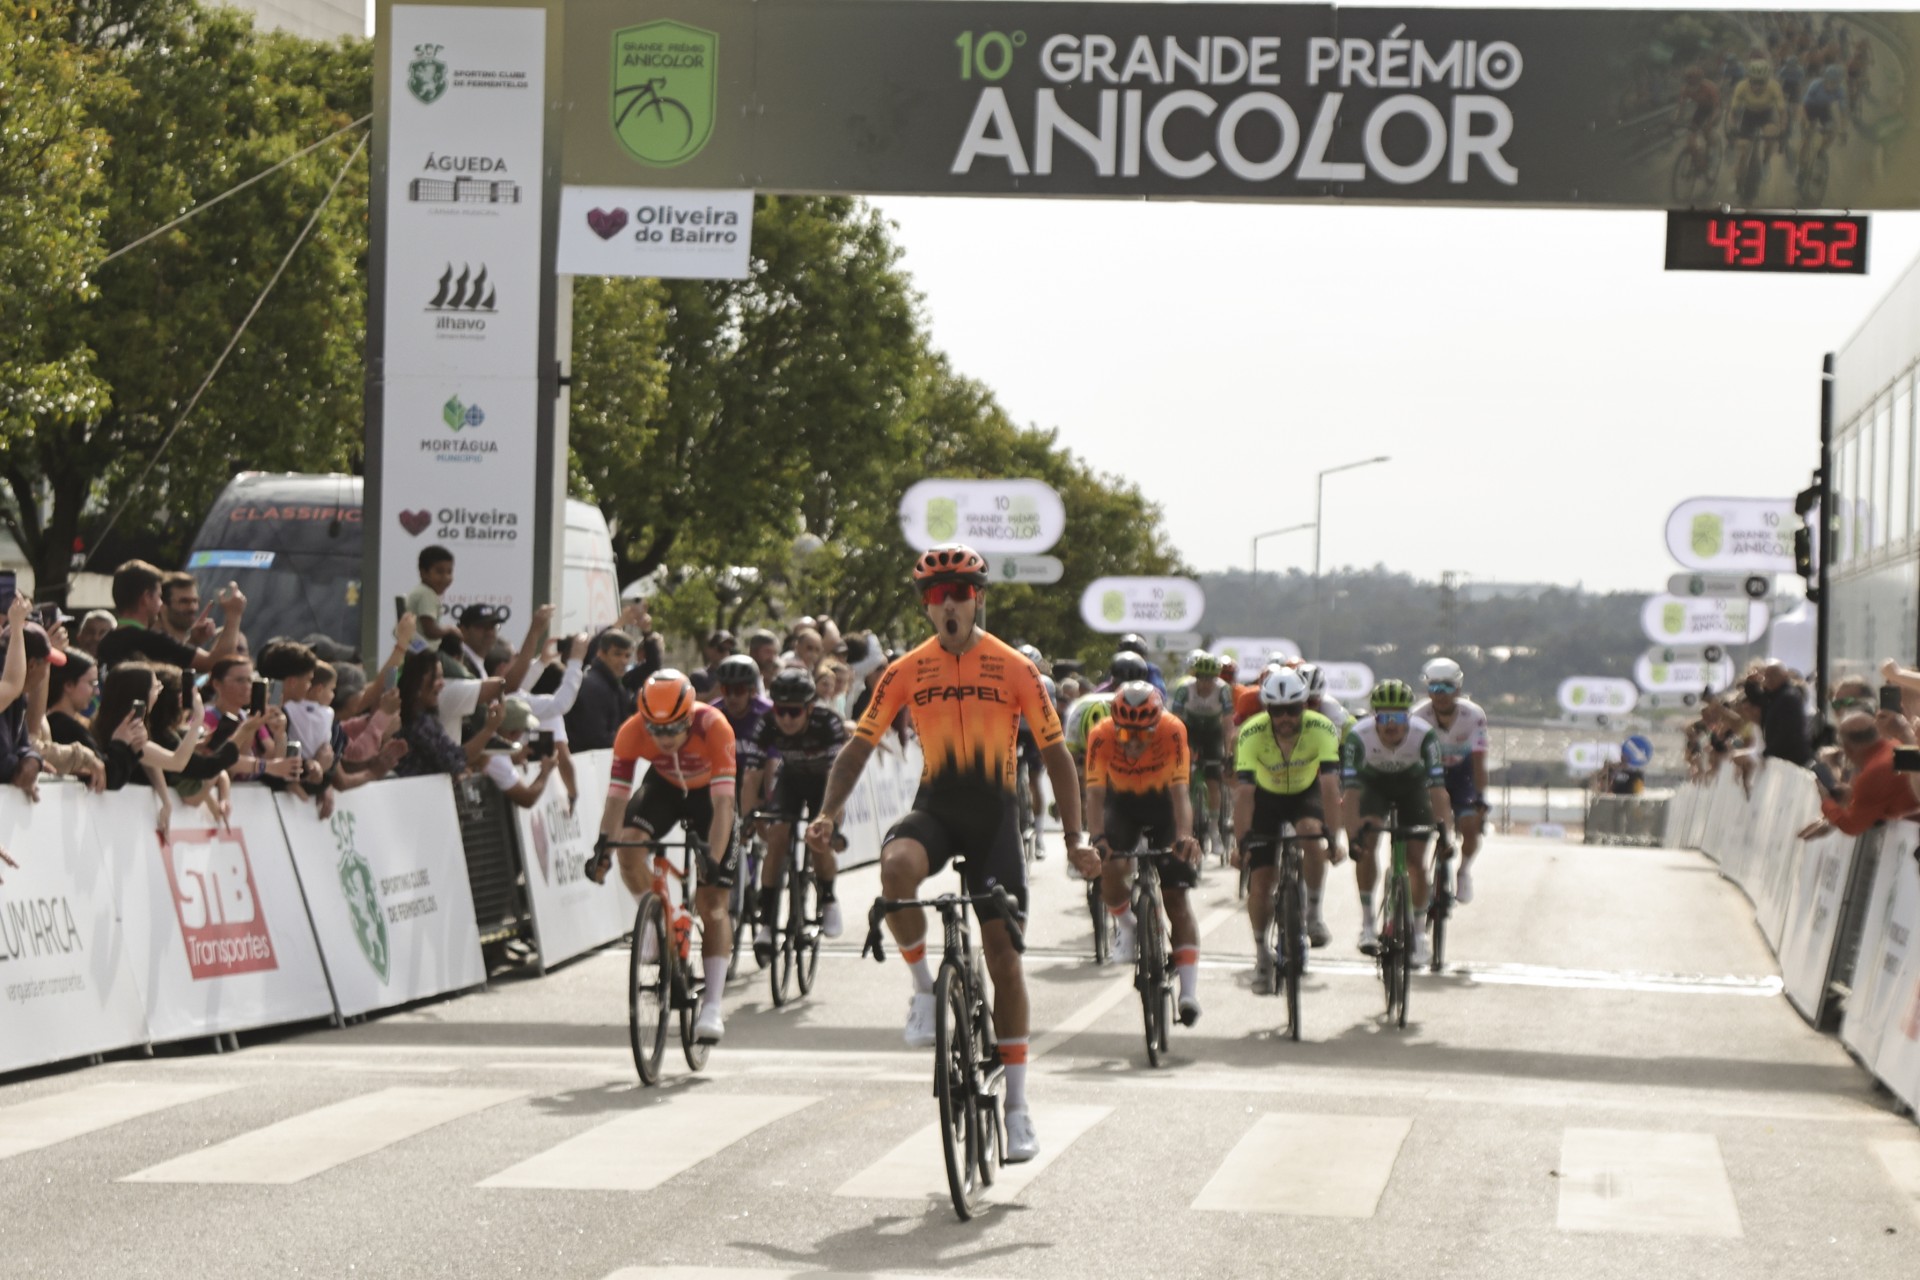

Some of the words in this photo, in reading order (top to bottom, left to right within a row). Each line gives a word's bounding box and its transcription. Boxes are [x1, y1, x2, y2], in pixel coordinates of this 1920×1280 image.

[623, 54, 705, 68] ANICOLOR
[1040, 34, 1281, 84] GRANDE
[1307, 23, 1523, 90] PRÉMIO
[498, 71, 527, 79] CLUBE
[950, 86, 1518, 185] ANICOLOR
[424, 152, 508, 173] ÁGUEDA
[636, 205, 739, 226] Oliveira
[634, 227, 664, 243] do
[670, 227, 738, 244] Bairro
[421, 437, 498, 453] MORTÁGUA
[995, 495, 1010, 511] 10
[437, 508, 518, 526] Oliveira
[1764, 512, 1779, 527] 10
[437, 526, 460, 540] do
[465, 526, 518, 541] Bairro
[968, 525, 1043, 540] ANICOLOR
[867, 669, 898, 720] EFAPEL
[914, 686, 1007, 706] EFAPEL
[172, 837, 256, 929] STB
[188, 931, 270, 968] Transportes
